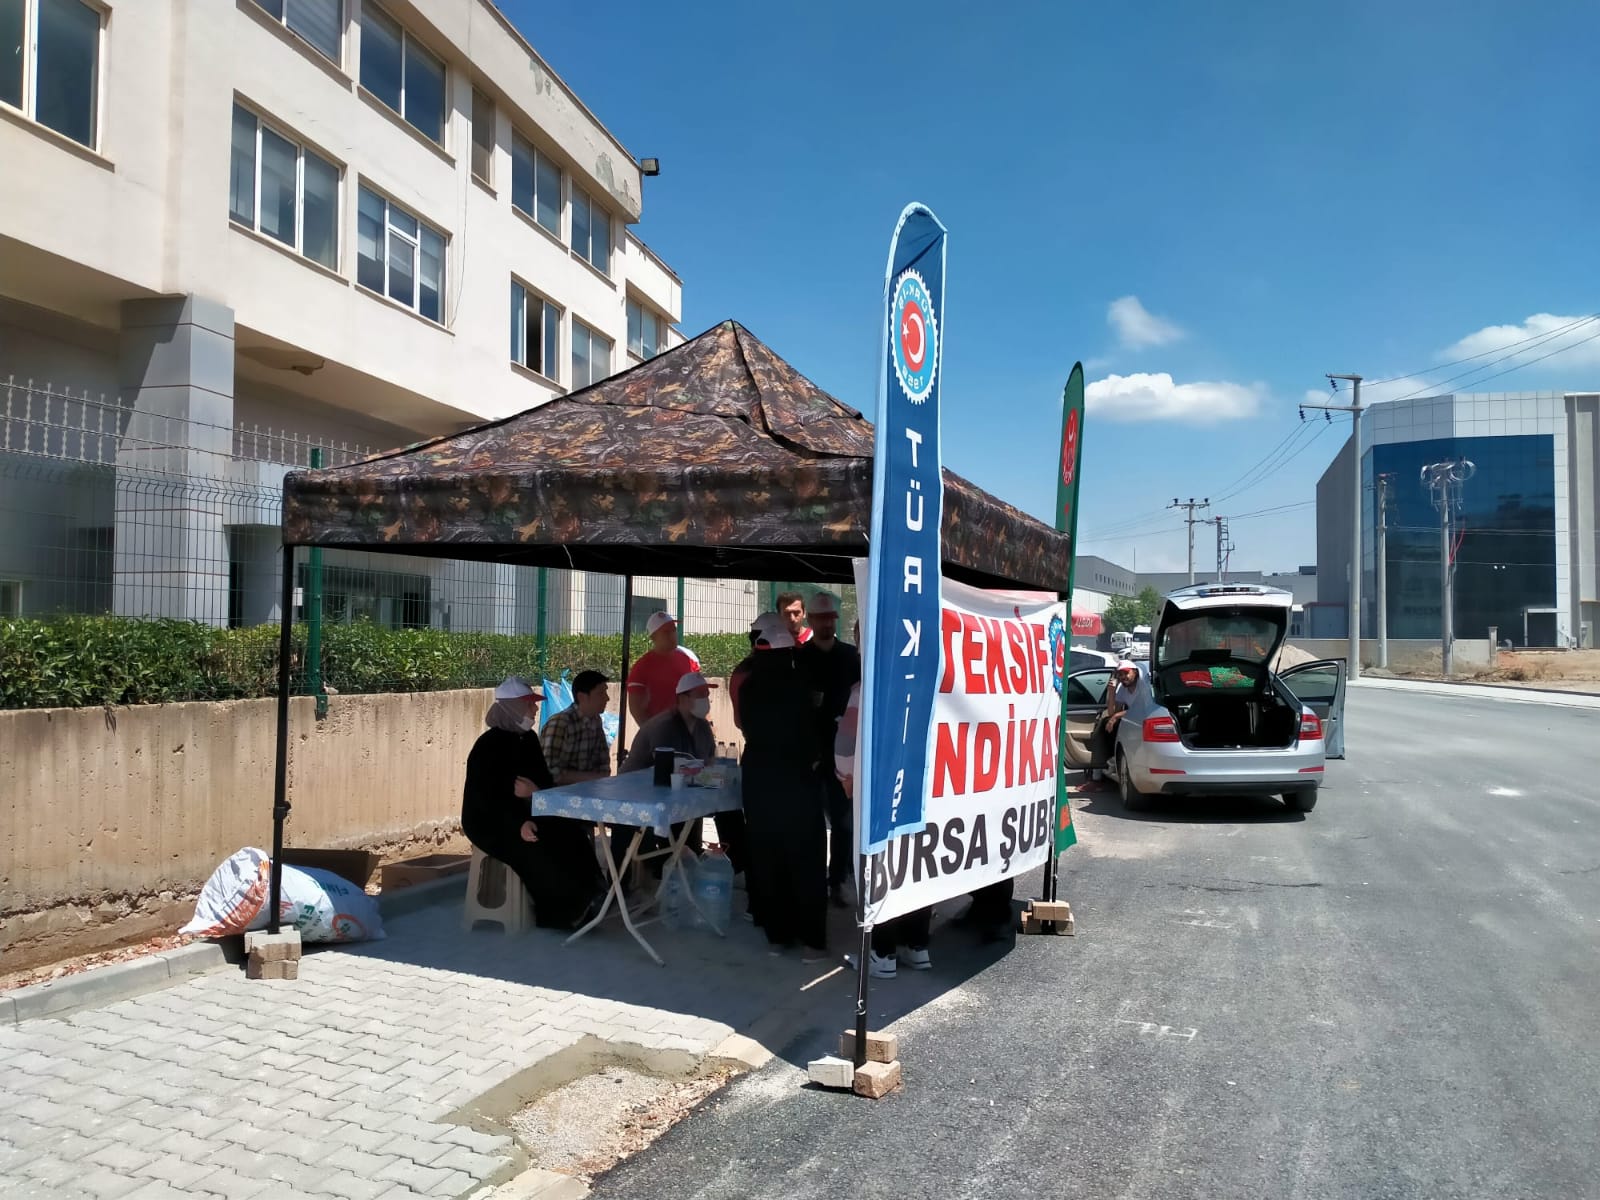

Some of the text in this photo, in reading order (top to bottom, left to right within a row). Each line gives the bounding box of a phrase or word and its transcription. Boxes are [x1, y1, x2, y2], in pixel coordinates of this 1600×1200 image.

[939, 606, 1049, 695] TEKSİF
[932, 703, 1061, 798] NDİKA
[869, 814, 989, 904] BURSA
